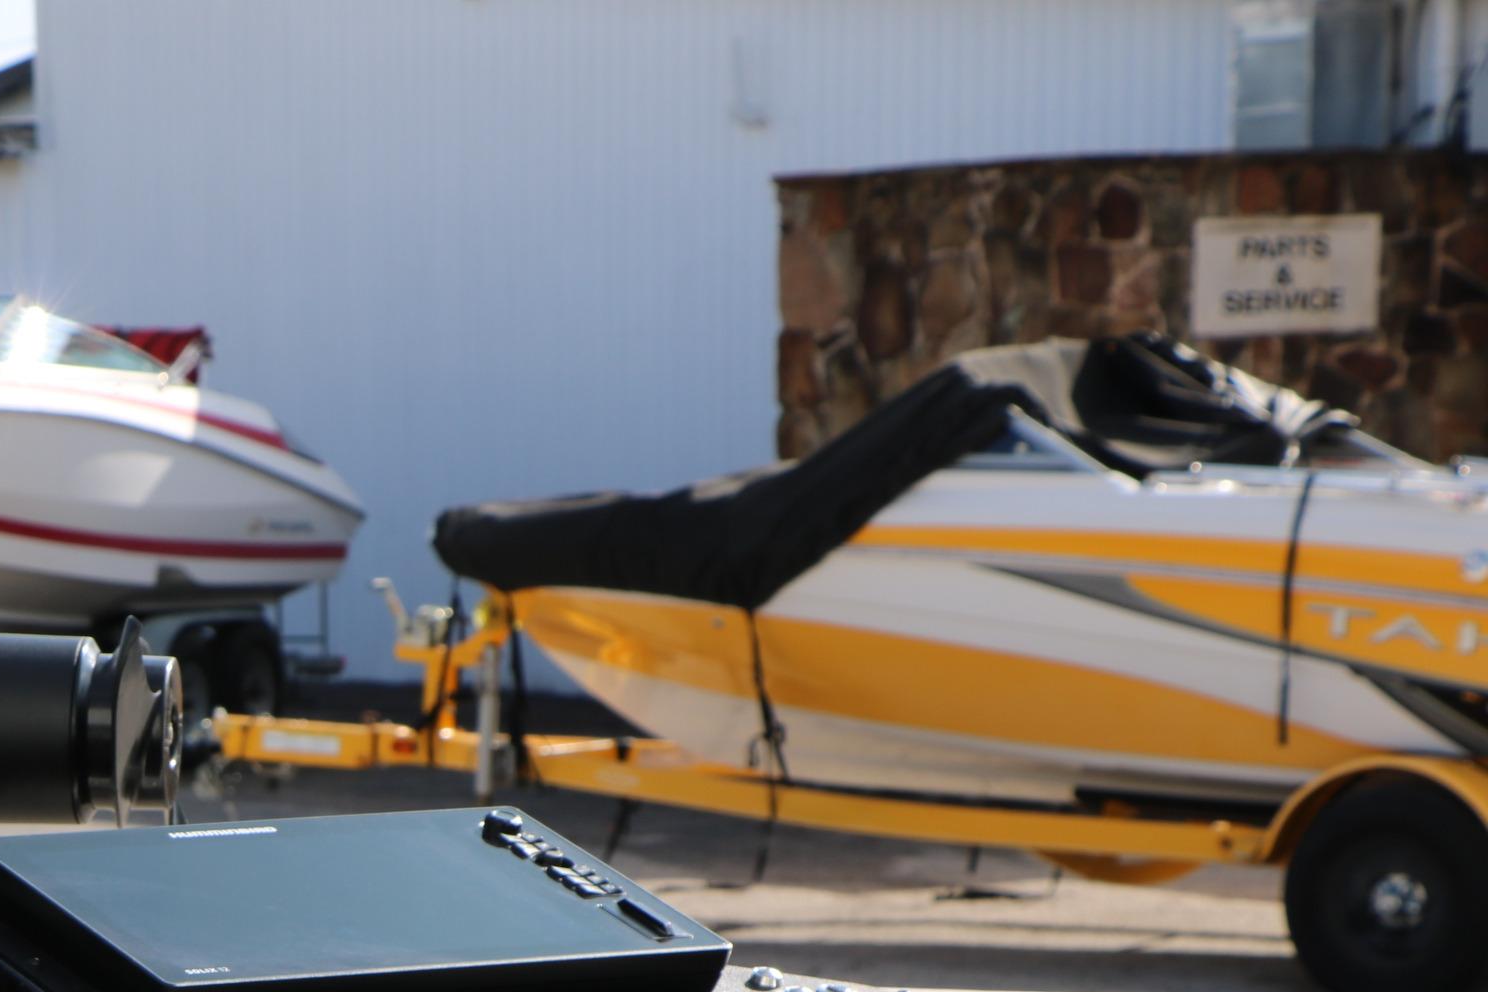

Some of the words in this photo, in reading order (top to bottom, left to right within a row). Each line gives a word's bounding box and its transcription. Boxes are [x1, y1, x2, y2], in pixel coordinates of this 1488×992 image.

[1237, 234, 1331, 260] PARTS
[1275, 262, 1294, 285] &
[1223, 287, 1345, 314] SERVICE
